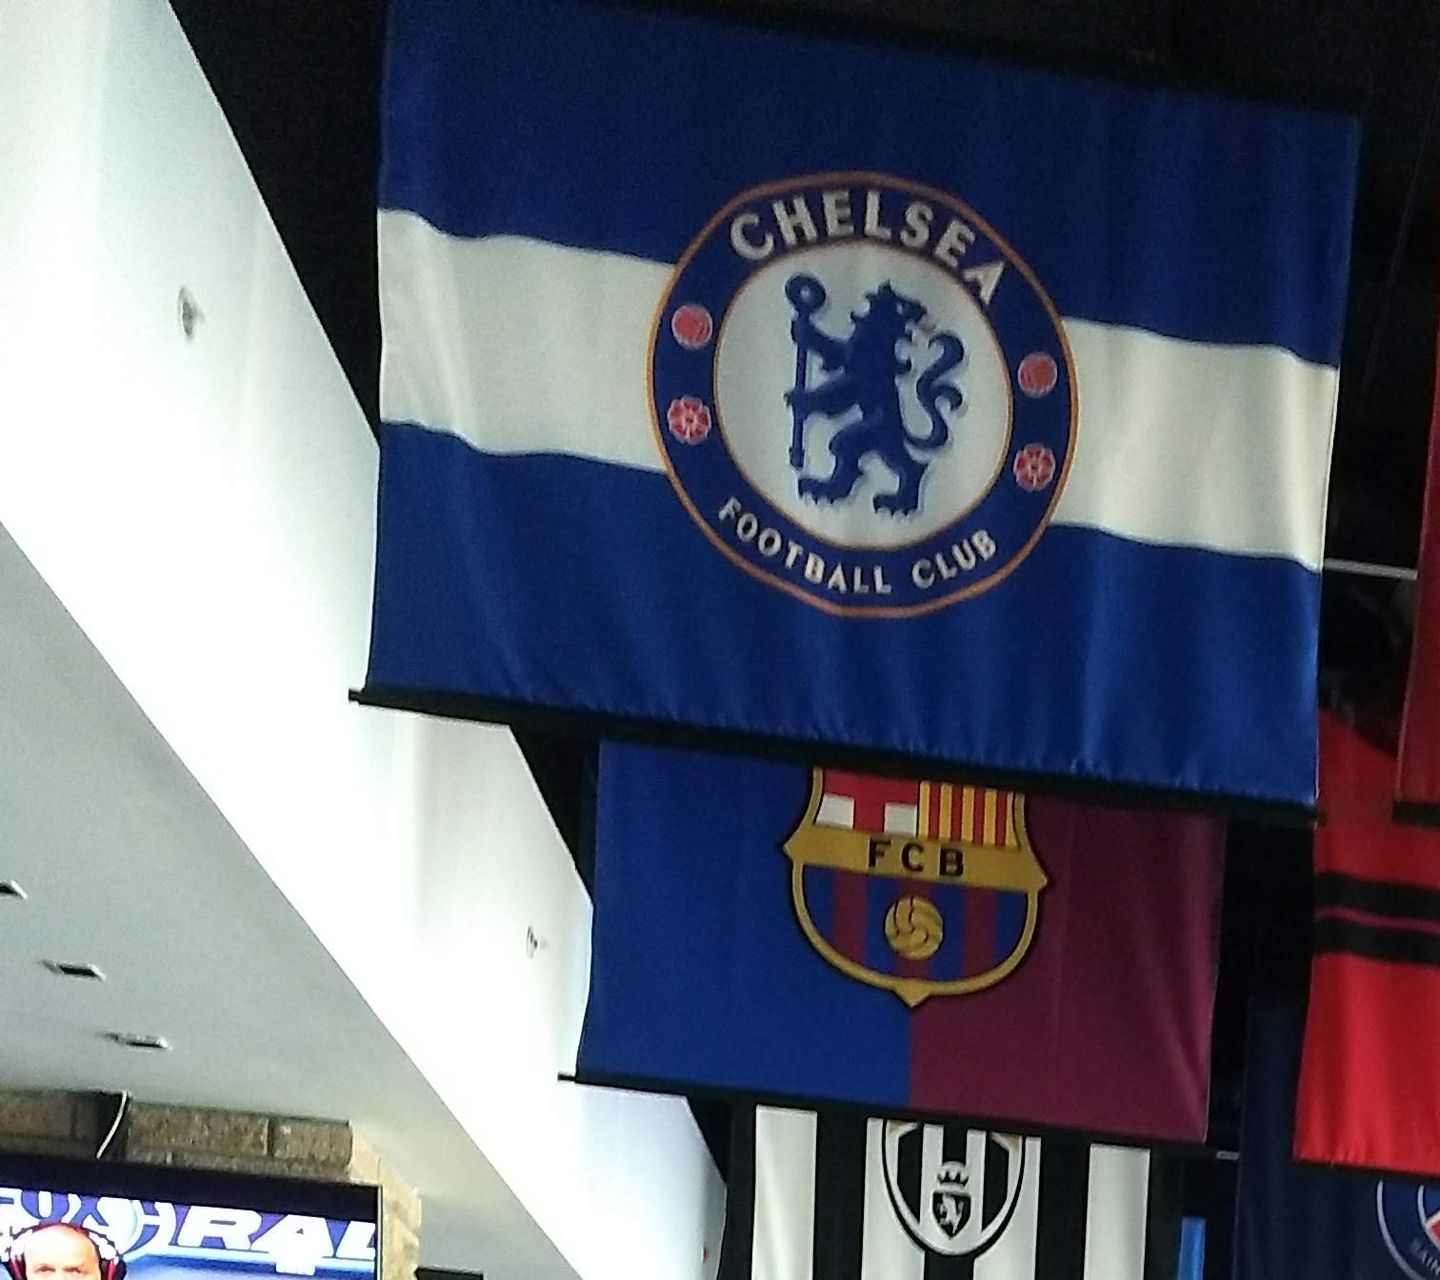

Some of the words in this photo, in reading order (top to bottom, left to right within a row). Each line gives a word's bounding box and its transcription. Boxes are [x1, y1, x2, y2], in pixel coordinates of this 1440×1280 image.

[730, 189, 1004, 305] CHELSEA
[718, 496, 892, 594] FOOTBALL
[912, 529, 996, 589] CLUB
[868, 838, 964, 877] FCB
